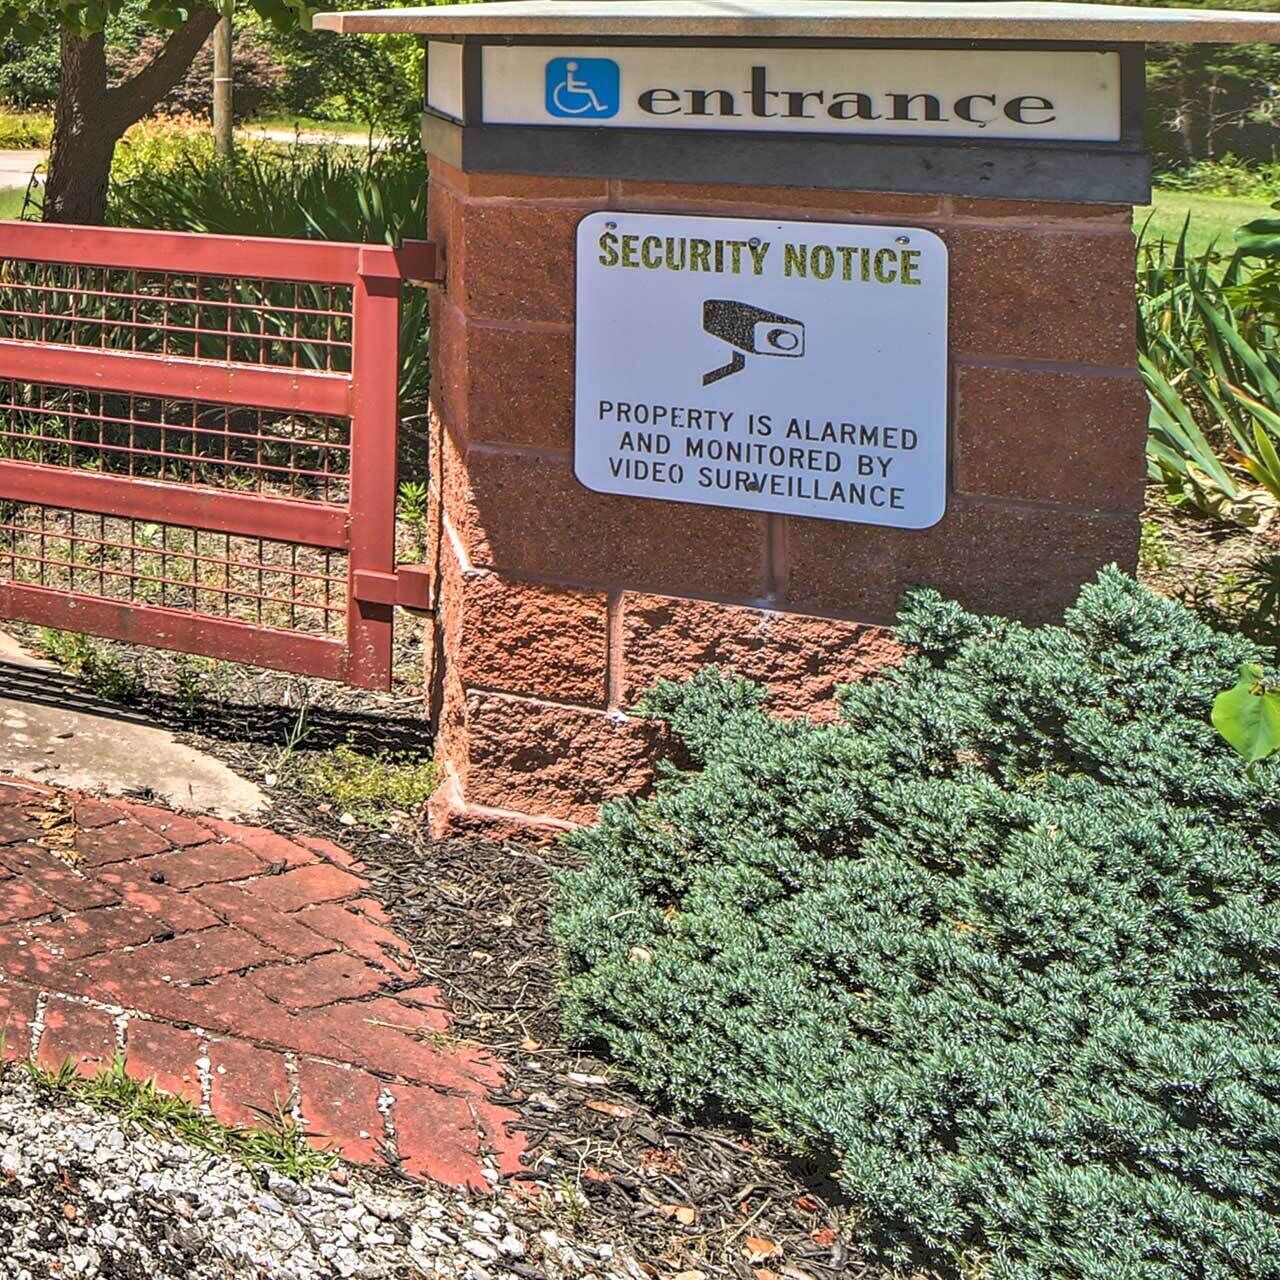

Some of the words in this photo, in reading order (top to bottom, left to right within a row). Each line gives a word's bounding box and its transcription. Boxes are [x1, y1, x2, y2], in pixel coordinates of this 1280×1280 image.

[637, 66, 1057, 128] entrance
[598, 231, 771, 276] SECURITY
[784, 243, 922, 286] NOTICE
[598, 400, 734, 433] PROPERTY
[748, 414, 773, 437] IS
[785, 418, 918, 451] ALARMED
[619, 431, 671, 455] AND
[686, 438, 841, 473] MONITORED
[857, 455, 893, 478] BY
[608, 457, 684, 484] VIDEO
[698, 467, 906, 510] SURVEILLANCE
